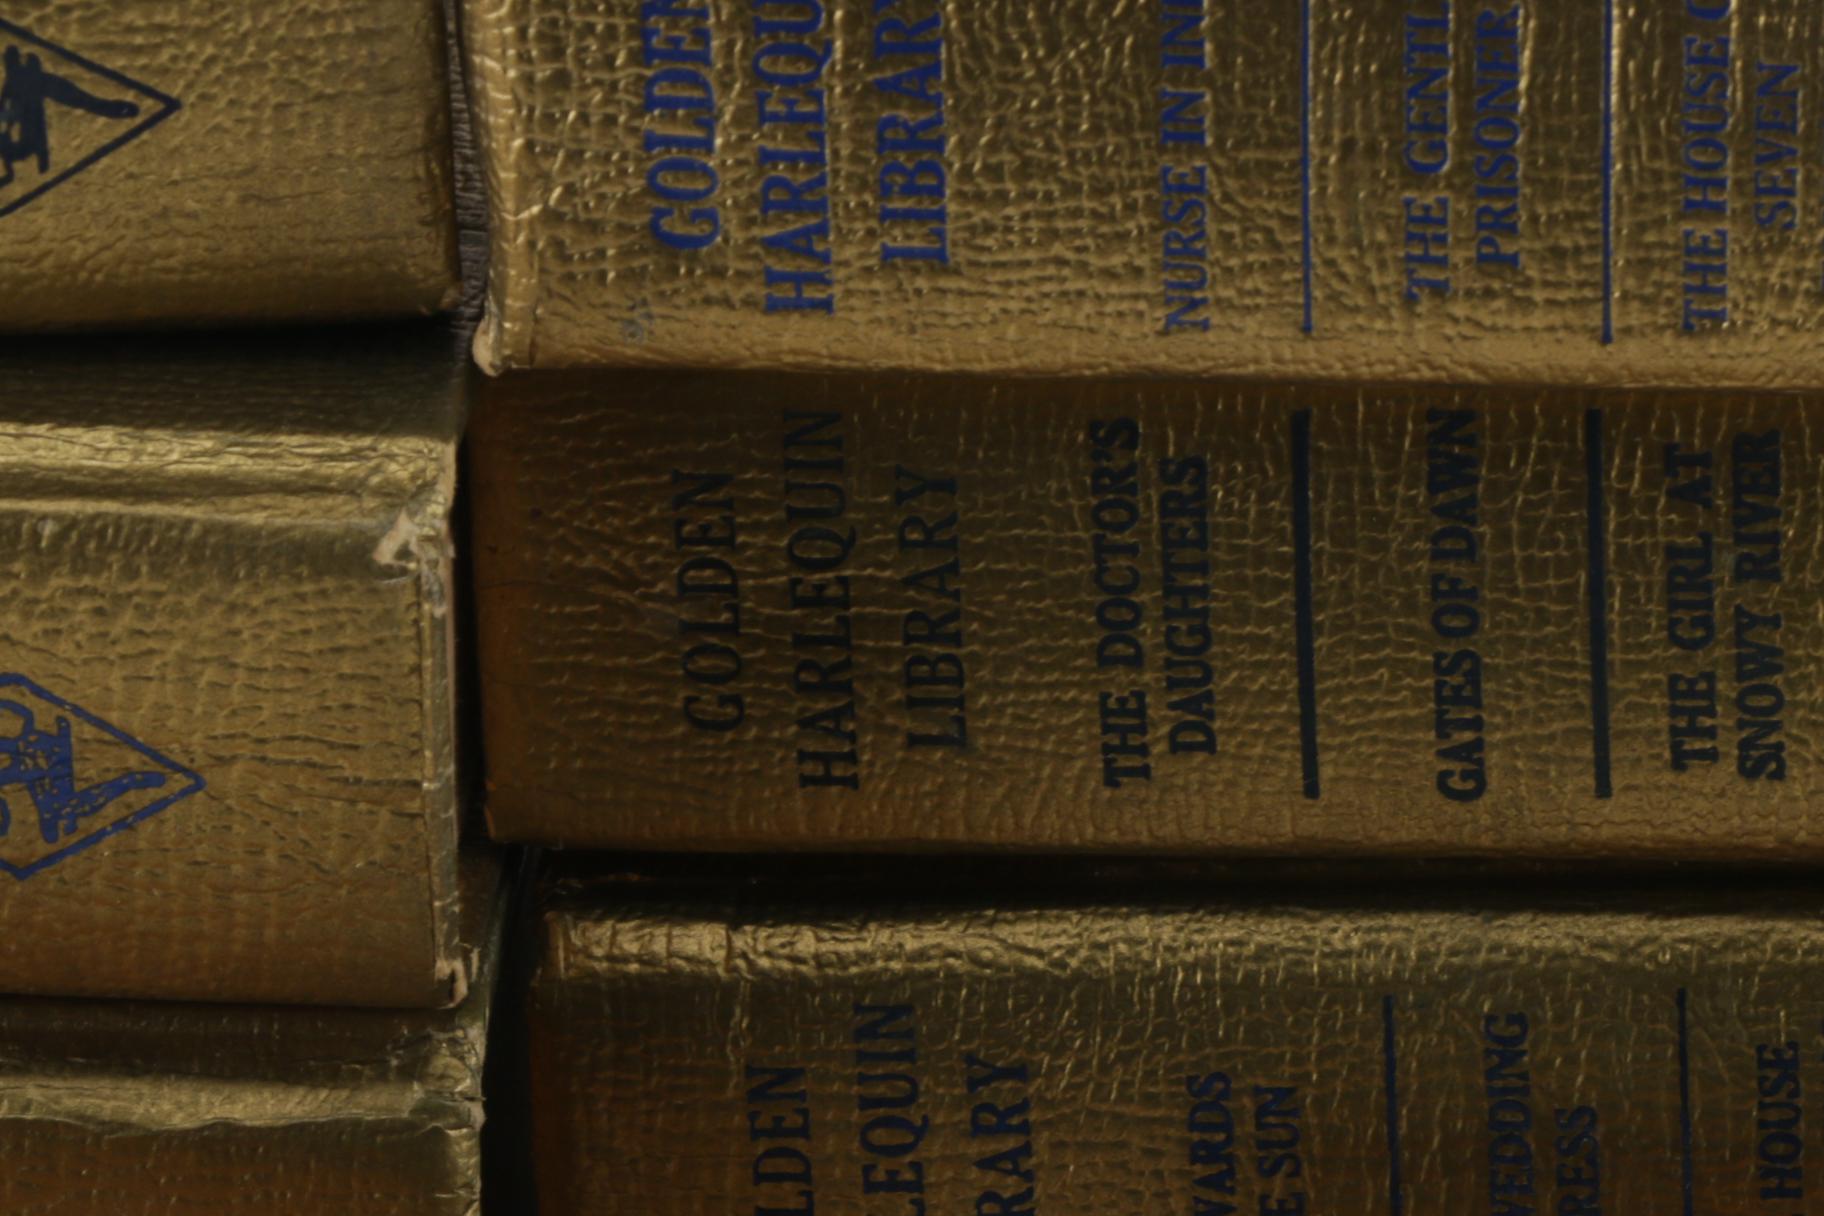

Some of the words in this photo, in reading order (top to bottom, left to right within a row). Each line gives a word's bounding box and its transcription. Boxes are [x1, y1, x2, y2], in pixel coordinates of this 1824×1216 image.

[1160, 0, 1208, 68] IN
[871, 0, 949, 265] LIBRAR
[1160, 92, 1208, 146] IN
[1473, 4, 1520, 268] PRISONER
[1683, 36, 1730, 211] HOUSE
[1754, 61, 1798, 228] SEVEN
[1158, 164, 1212, 333] NURSE
[1404, 196, 1452, 300] THE
[1682, 228, 1728, 330] THE
[1091, 417, 1146, 669] DOCTOR'S
[1427, 408, 1480, 563] DAWN
[1665, 442, 1713, 512] AT
[1733, 428, 1782, 582] RIVER
[672, 469, 746, 731] GOLDEN
[784, 408, 858, 790] HARLEQUIN
[896, 465, 967, 749] LIBRARY
[1158, 456, 1217, 755] DAUGHTERS
[1431, 573, 1480, 638] OF
[1667, 532, 1716, 651] GIRL
[1103, 690, 1150, 787] THE
[1436, 650, 1488, 802] GATES
[1670, 672, 1719, 771] THE
[1735, 605, 1786, 780] SNOWY
[1254, 1086, 1302, 1178] SUN
[1756, 1041, 1803, 1200] HOUSE
